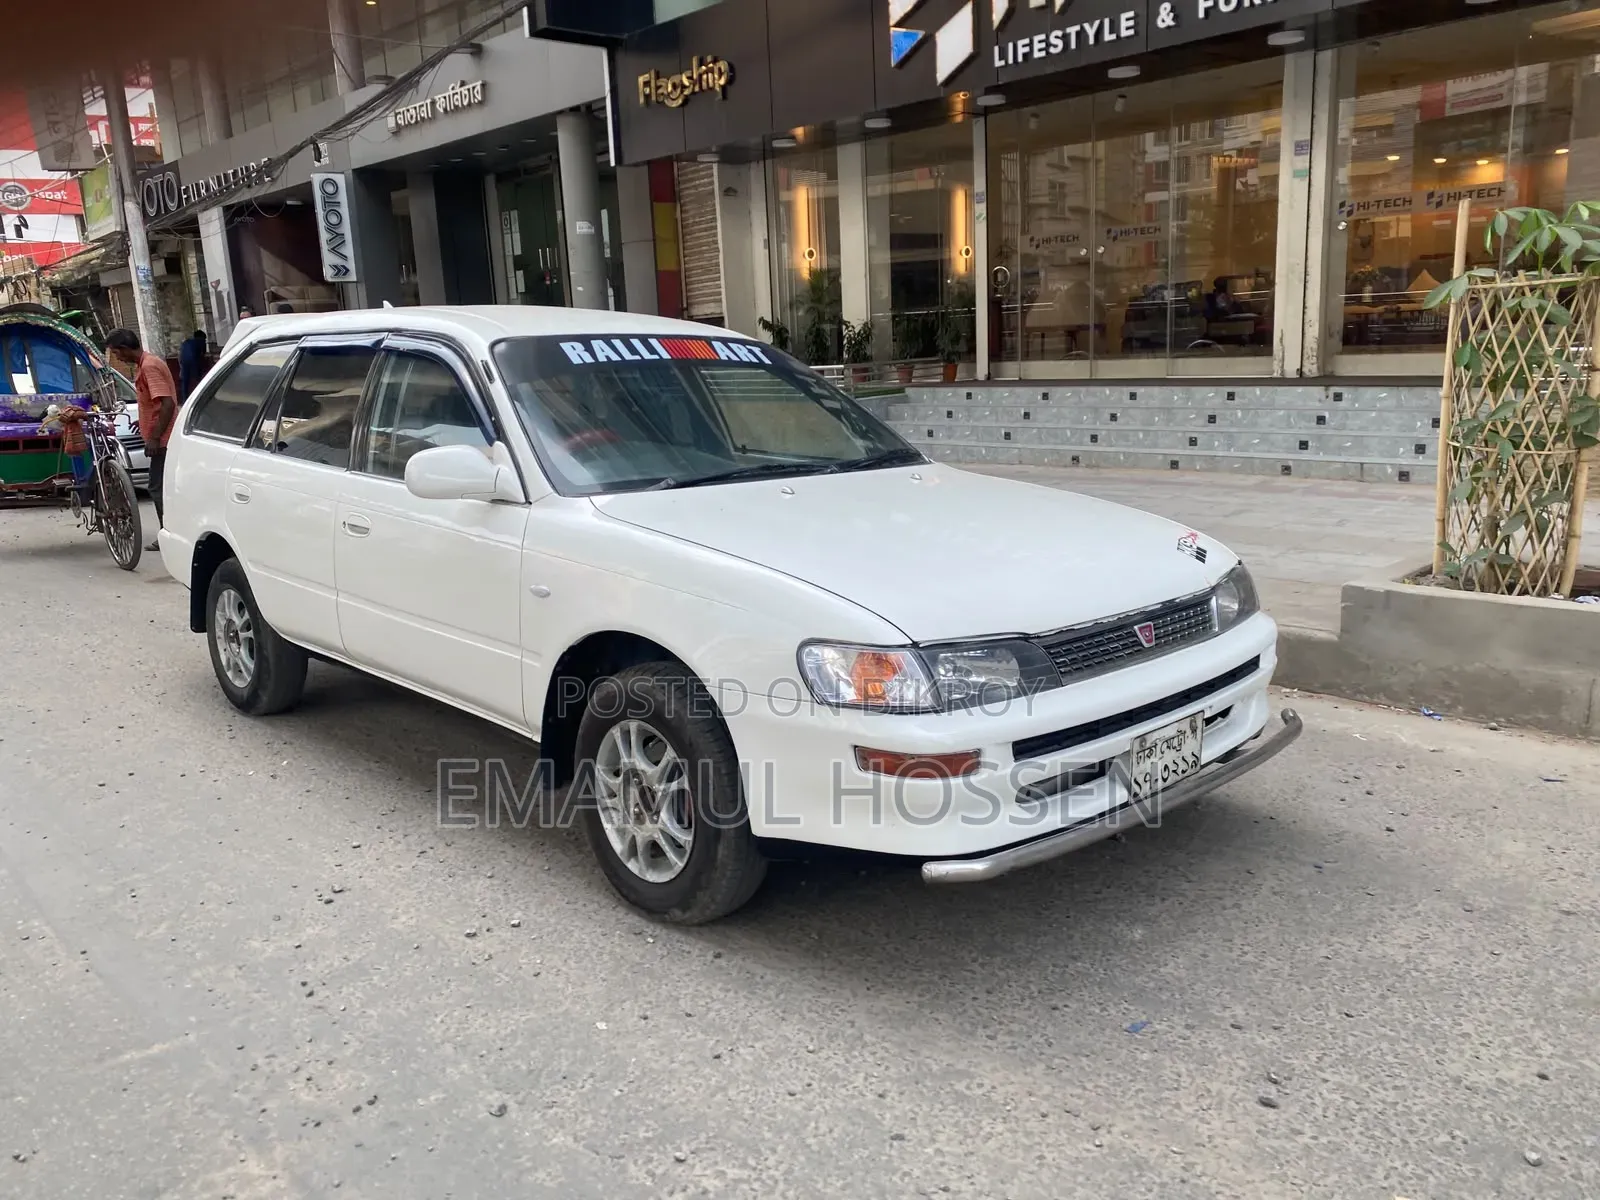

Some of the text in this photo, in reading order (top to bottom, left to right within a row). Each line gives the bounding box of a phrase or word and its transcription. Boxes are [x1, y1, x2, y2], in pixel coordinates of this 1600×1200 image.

[993, 10, 1136, 67] LIFESTYLE
[1157, 2, 1176, 28] &
[638, 55, 730, 107] Flagship
[434, 80, 482, 113] ফার্নিচার
[134, 171, 178, 216] YOTO
[1356, 197, 1412, 211] HI-TECH
[319, 177, 348, 261] AYOTO
[1120, 226, 1161, 237] HI-TECH
[1041, 234, 1080, 245] HI-TECH
[559, 338, 772, 364] RALLI ART
[1136, 742, 1157, 765] ঢাকা
